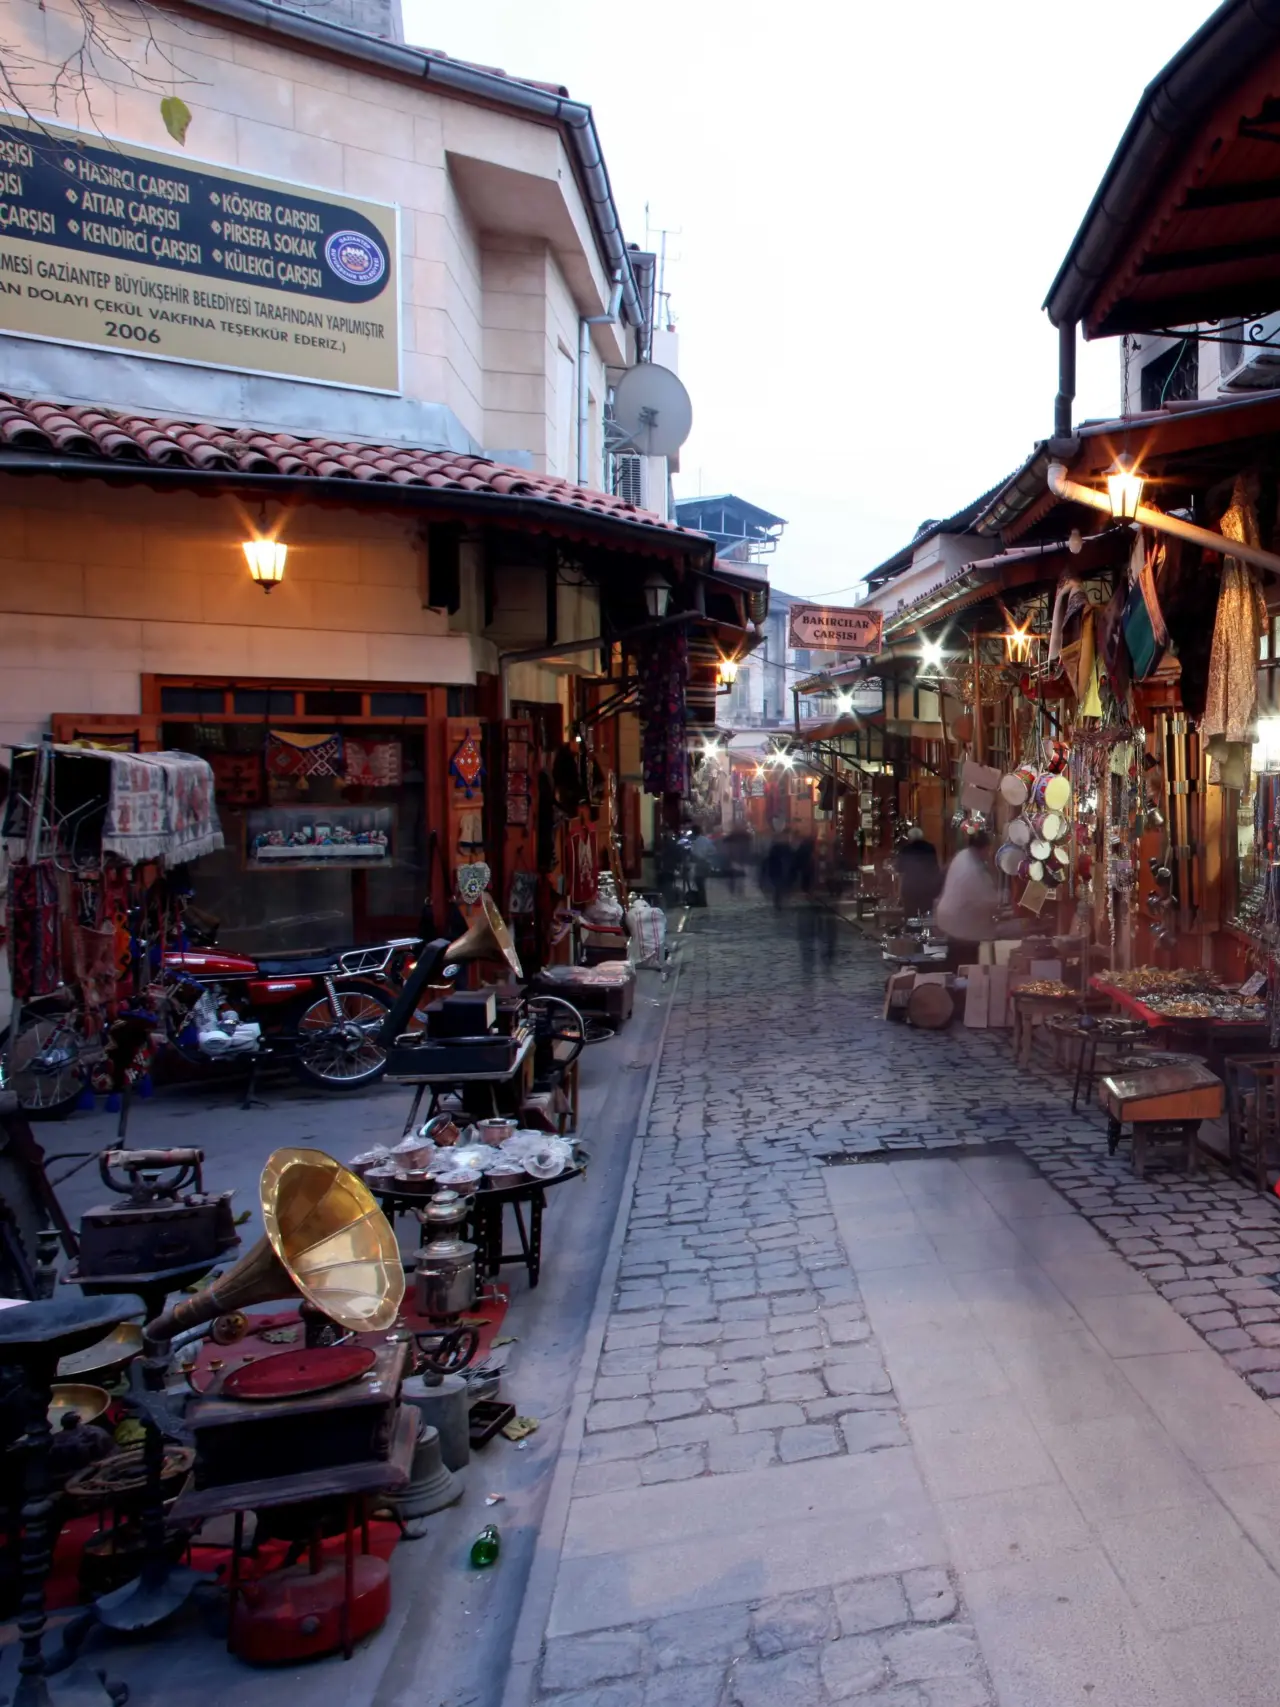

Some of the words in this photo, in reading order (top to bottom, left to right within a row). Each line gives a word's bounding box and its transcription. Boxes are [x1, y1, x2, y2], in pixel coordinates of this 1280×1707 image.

[78, 159, 135, 191] HASIRCI
[138, 174, 190, 204] ÇARŞISI
[81, 191, 125, 219] ATTAR
[128, 201, 180, 231] ÇARŞISI
[222, 192, 272, 223] KÖŞKER
[81, 221, 148, 253] KENDİRCİ
[151, 237, 201, 264] ÇARŞISI
[223, 219, 271, 250] PİRSEFA
[273, 234, 317, 259] SOKAK
[224, 250, 274, 279] KÜLEKCİ
[277, 261, 322, 290] ÇARŞISI
[28, 286, 89, 308] DOLAYI
[94, 298, 143, 317] ÇEKÜL
[148, 308, 216, 330] VAKFINA
[220, 320, 289, 342] TEŞEKKÜR
[37, 261, 110, 289] GAZİANTEP
[114, 272, 190, 304] BÜYÜKŞEHİR
[193, 290, 251, 316] BELEDİYESİ
[254, 301, 323, 328] TARAFINDAN
[326, 315, 385, 340] YAPILMIŞTIR
[104, 321, 161, 344] 2006
[802, 615, 869, 629] BAKIRCILAR
[813, 629, 857, 641] ÇARŞISI
